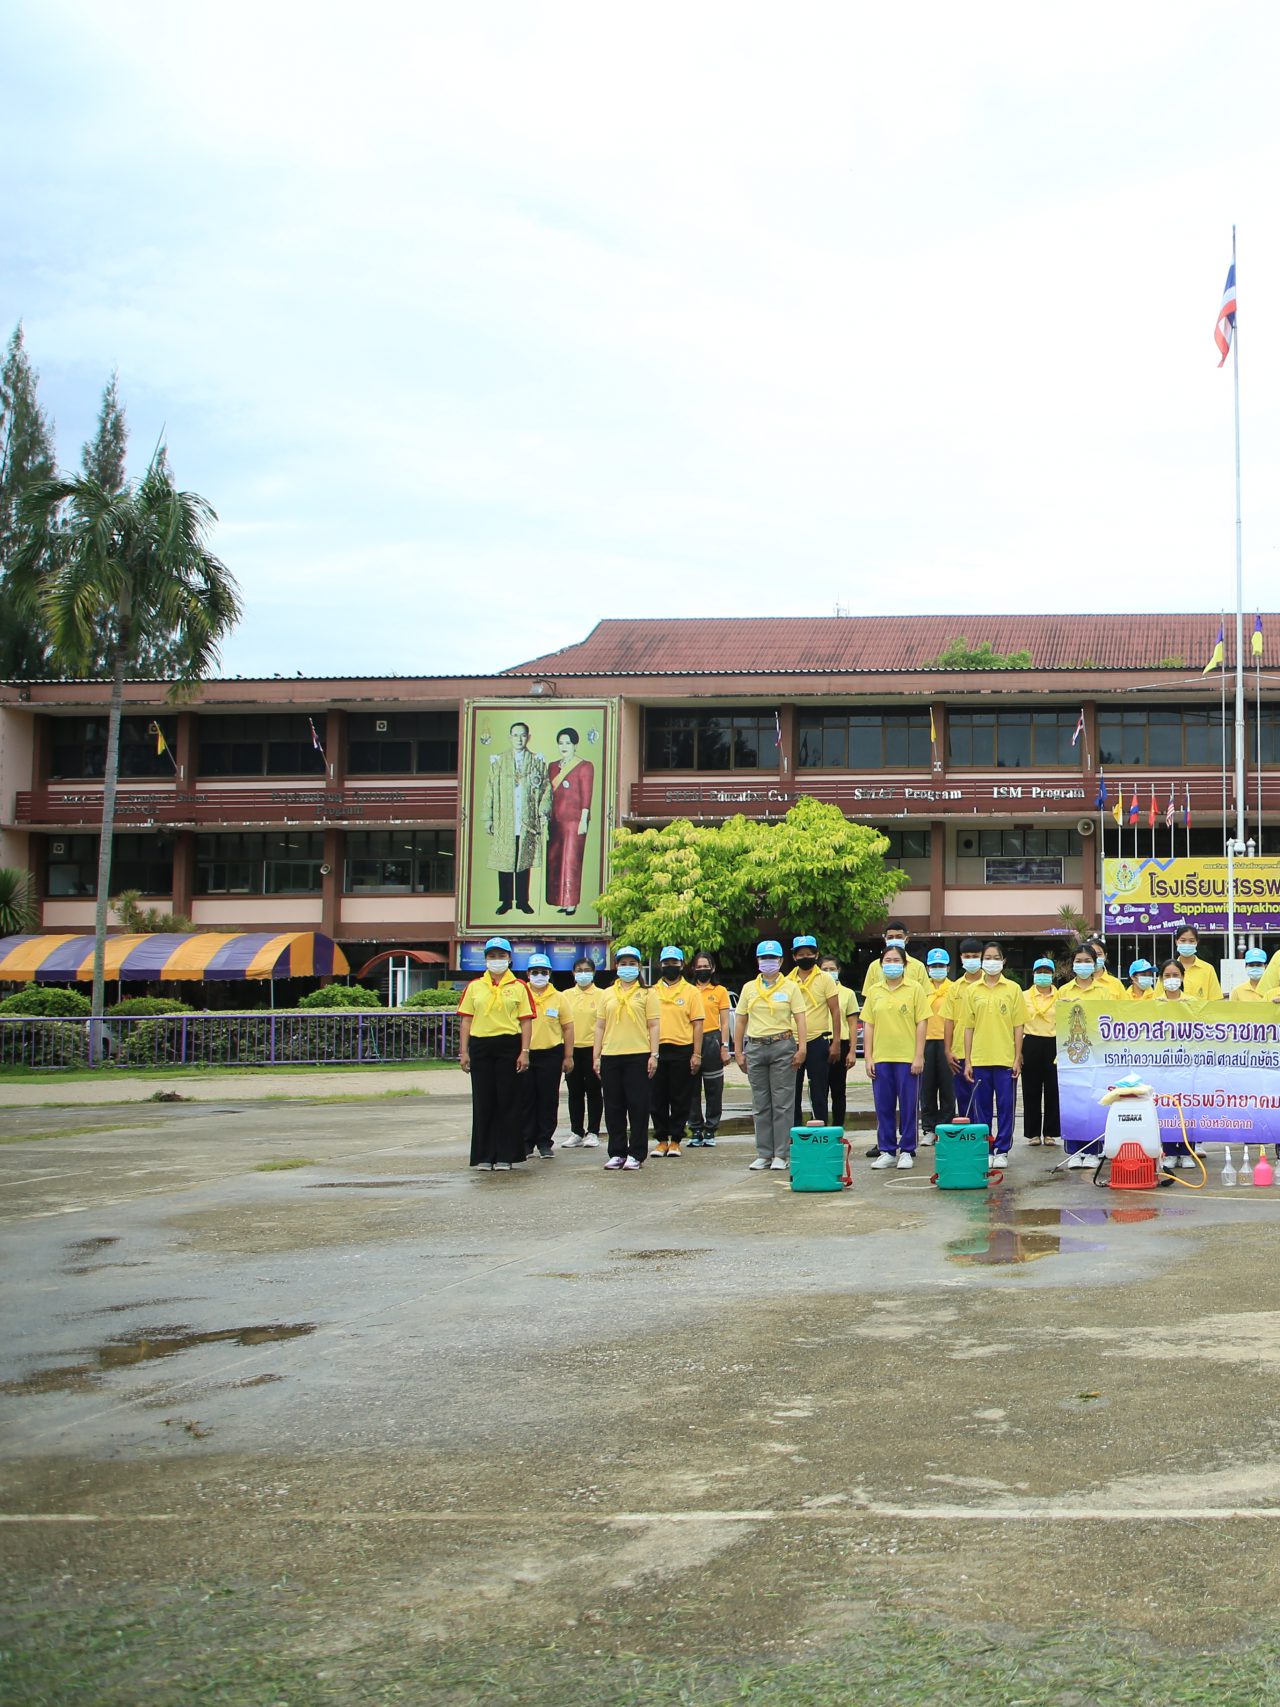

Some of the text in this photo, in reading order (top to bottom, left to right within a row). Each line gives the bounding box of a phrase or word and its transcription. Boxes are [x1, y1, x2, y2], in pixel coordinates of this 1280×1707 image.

[904, 787, 963, 802] Program
[992, 786, 1086, 801] ISM Program
[1104, 1044, 1191, 1065] เราทำความดีเพื่อ
[1193, 1050, 1214, 1066] ชาติ
[1217, 1050, 1247, 1066] ศาสน์
[1200, 1115, 1253, 1129] จังหวัดตาก
[811, 1135, 829, 1144] AIS
[960, 1132, 977, 1141] AIS
